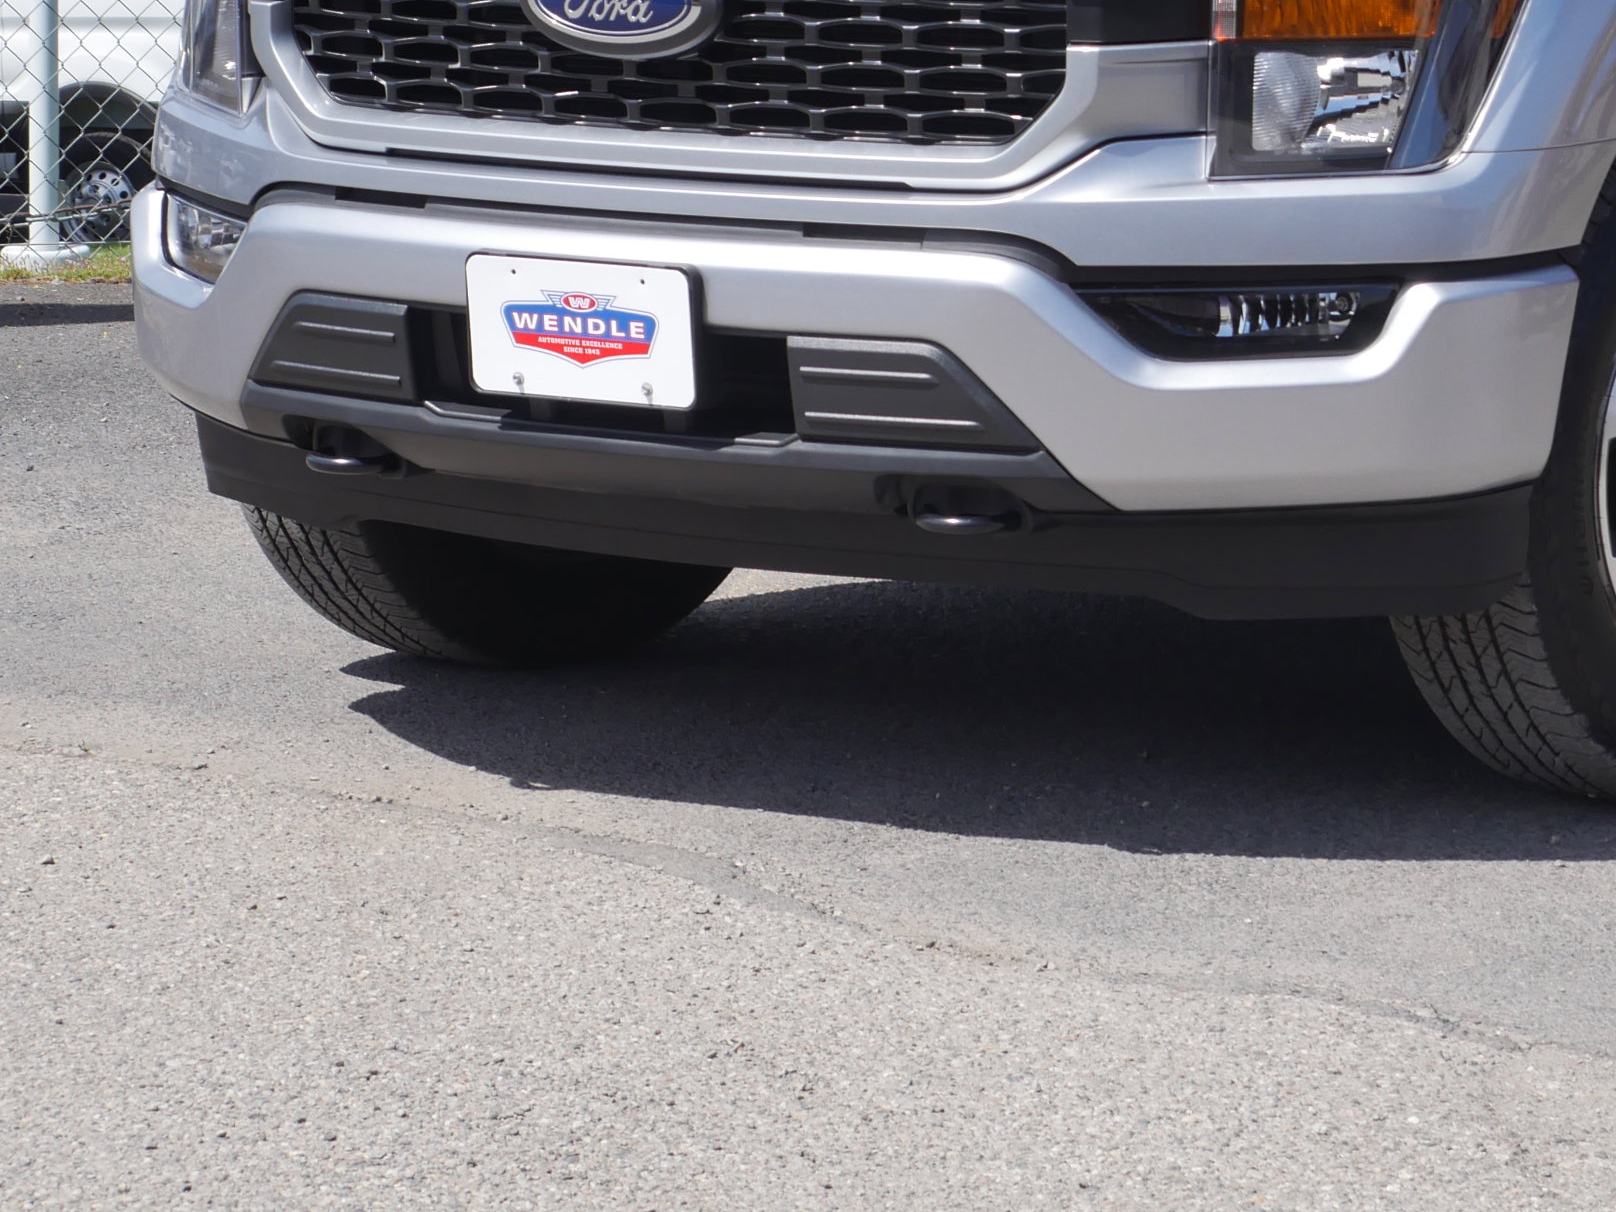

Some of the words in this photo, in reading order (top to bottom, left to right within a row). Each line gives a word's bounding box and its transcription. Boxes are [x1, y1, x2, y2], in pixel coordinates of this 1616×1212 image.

[512, 312, 646, 339] WENDLE
[538, 336, 580, 346] AUTOMOTIVE
[582, 339, 623, 350] EXCELLENCE
[563, 346, 583, 354] SINCE
